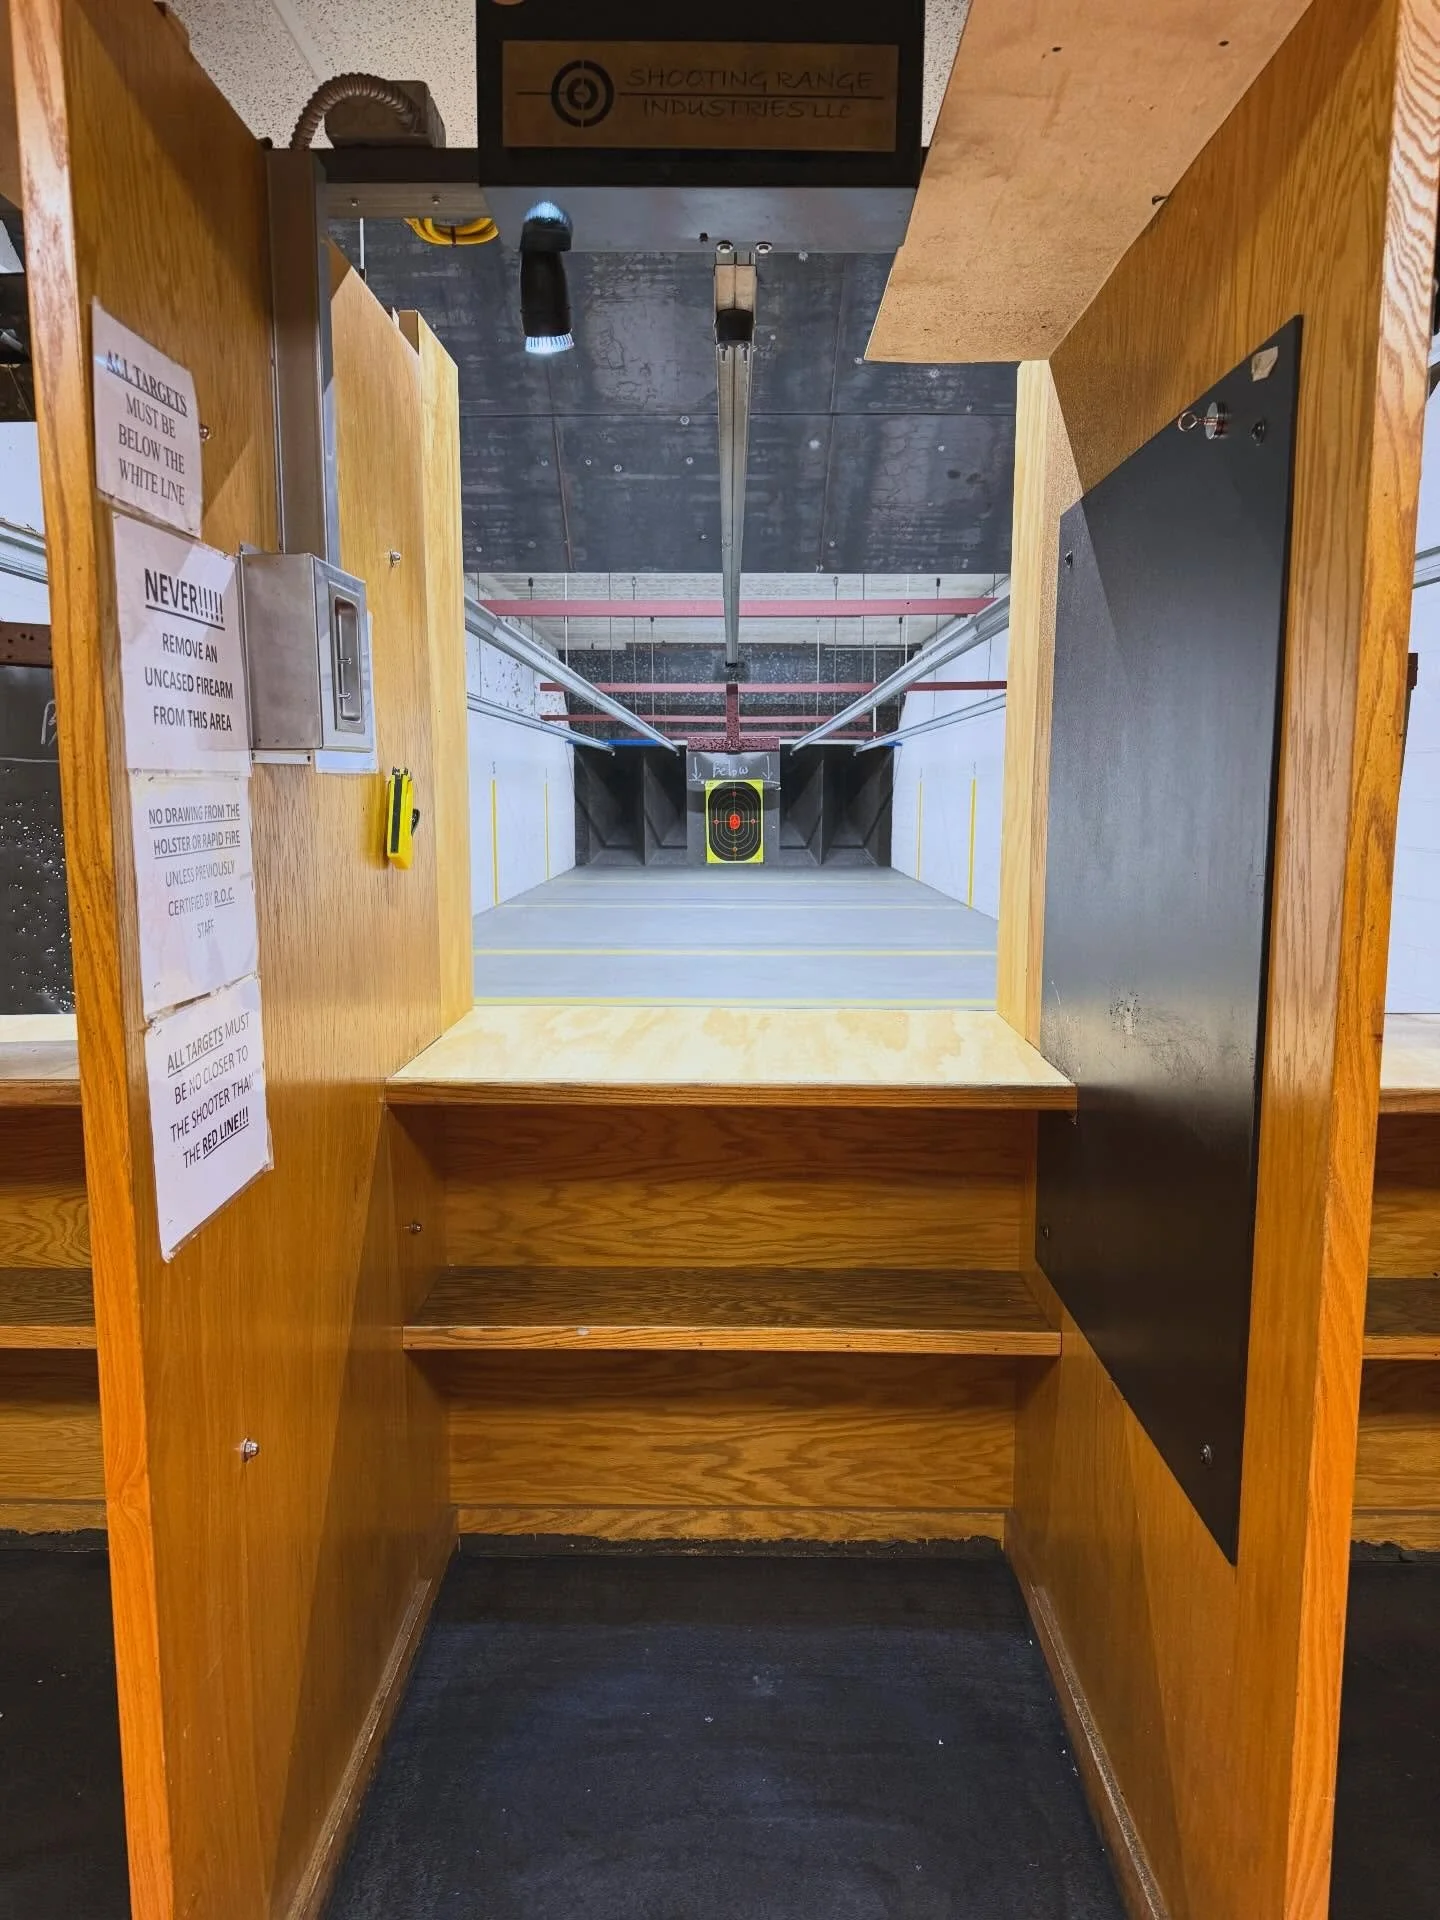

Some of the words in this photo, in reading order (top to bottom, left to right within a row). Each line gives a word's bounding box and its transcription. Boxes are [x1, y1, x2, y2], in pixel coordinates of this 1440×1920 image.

[625, 68, 770, 93] SHOOTING
[778, 71, 874, 94] RANGE
[643, 99, 803, 119] INDUSTRIES
[106, 350, 132, 382] ALL
[133, 365, 188, 414] TARGETS
[126, 393, 159, 429] MUST
[161, 414, 176, 438] BE
[118, 423, 161, 462] BELOW
[163, 447, 185, 475] THE
[118, 458, 158, 495] WHITE
[160, 477, 185, 506] LINE
[144, 568, 224, 624] NEVER!!!!!
[162, 632, 203, 661] REMOVE
[205, 645, 218, 664] AN
[144, 666, 194, 693] UNCASED
[196, 676, 234, 700] FIREARM
[153, 705, 186, 728] FROM
[187, 709, 208, 730] THIS
[209, 712, 232, 732] AREA
[148, 807, 163, 825] NO
[165, 805, 203, 824] DRAWING
[204, 804, 225, 820] FROM
[226, 803, 240, 818] THE
[153, 837, 191, 856] HOLSTER
[192, 835, 201, 850] OR
[201, 832, 224, 849] RAPID
[225, 830, 240, 845] FIRE
[165, 867, 195, 887] UNLESS
[195, 860, 235, 880] PREVIOUSLY
[168, 894, 204, 917] CERTIFIED
[204, 892, 213, 908] BY
[214, 887, 235, 904] R.O.C.
[167, 1049, 185, 1073] ALL
[186, 1026, 224, 1059] TARGETS
[224, 1012, 251, 1037] MUST
[174, 1083, 188, 1105] BE
[188, 1075, 202, 1096] NO
[203, 1056, 235, 1085] CLOSER
[236, 1044, 249, 1063] TO
[170, 1115, 191, 1143] THE
[191, 1087, 231, 1127] SHOOTER
[183, 1142, 201, 1169] THE
[202, 1130, 218, 1156] RED
[219, 1106, 249, 1140] LINE!!!
